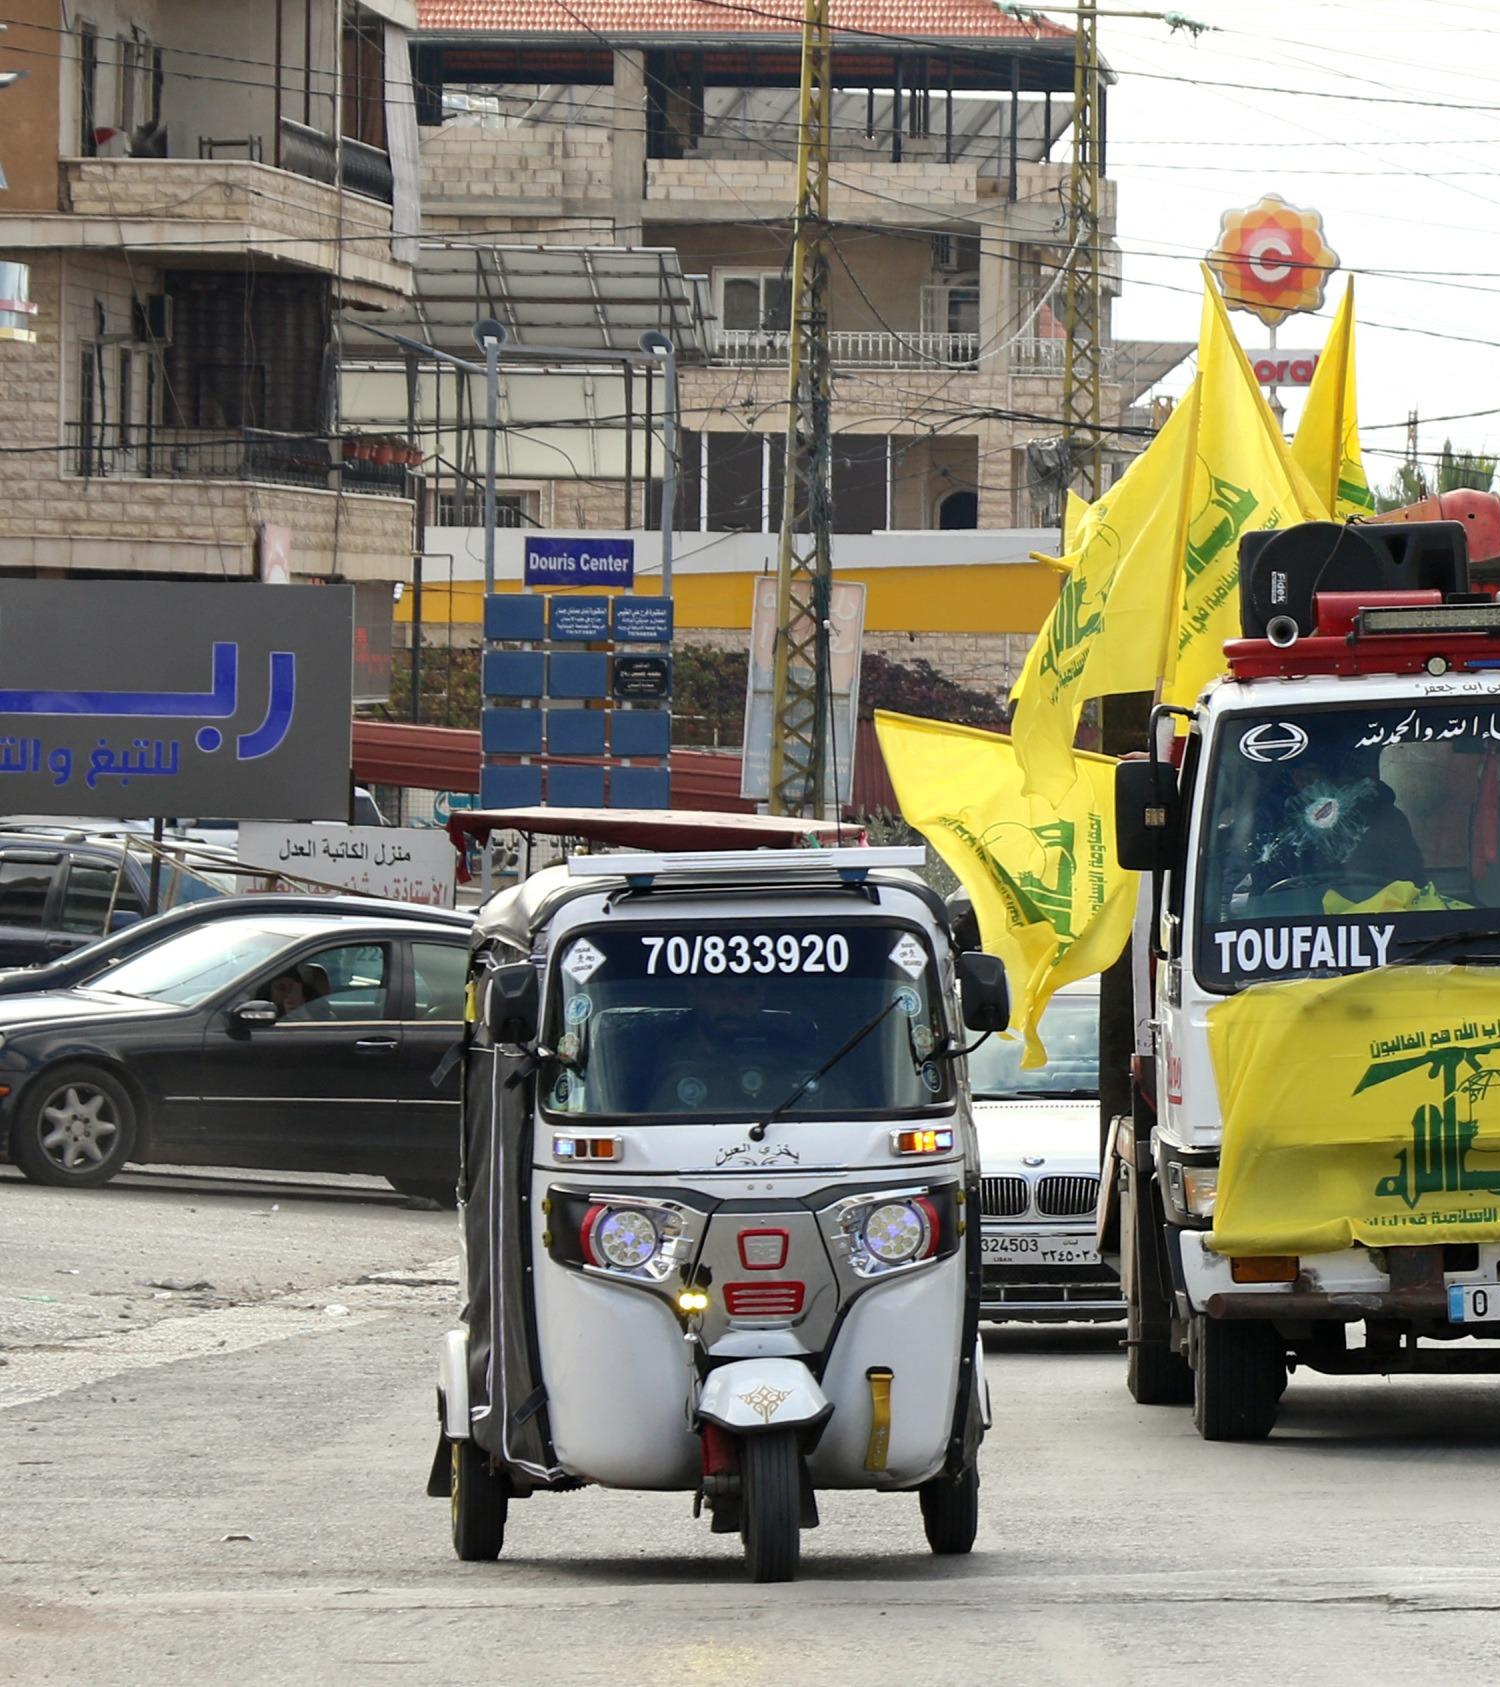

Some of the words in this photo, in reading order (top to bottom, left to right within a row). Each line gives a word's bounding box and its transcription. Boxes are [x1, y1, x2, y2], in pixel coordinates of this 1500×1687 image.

[1250, 237, 1293, 284] C
[1251, 355, 1320, 383] ora
[528, 552, 576, 571] Douris
[579, 553, 629, 573] Center
[86, 738, 180, 790] للتبغ
[278, 838, 318, 861] العدل
[322, 837, 369, 861] الكاتبة
[373, 844, 412, 866] منزل
[641, 933, 850, 975] 70/833920
[1213, 924, 1396, 974] TOUFAILY
[1429, 1029, 1451, 1048] هم
[1454, 1017, 1479, 1041] الله
[715, 1143, 751, 1167] العين
